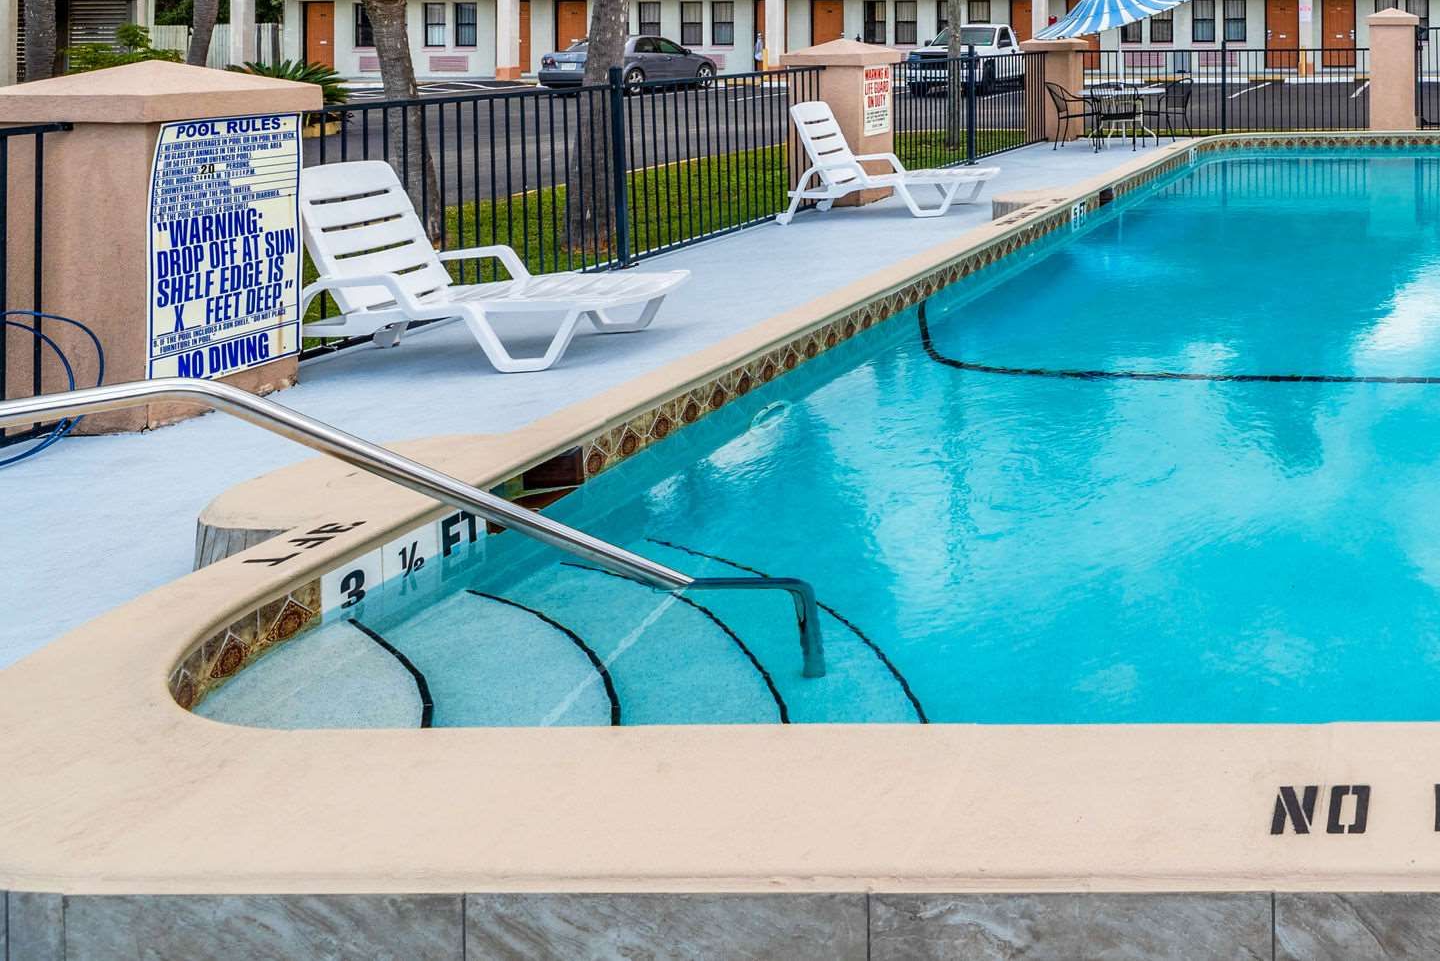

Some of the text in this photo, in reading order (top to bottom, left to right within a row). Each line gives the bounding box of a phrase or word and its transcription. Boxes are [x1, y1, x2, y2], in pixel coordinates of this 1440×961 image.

[865, 82, 873, 95] LIFE
[874, 94, 886, 108] DUTY
[176, 122, 220, 139] POOL
[227, 118, 280, 134] RULES
[201, 164, 215, 174] 20
[157, 228, 294, 279] DROP OFF AT SUN
[157, 256, 284, 308] SHELF EDGE IS
[206, 292, 242, 324] FEET
[166, 335, 176, 344] THE
[178, 331, 190, 341] POOL
[193, 325, 216, 337] INCLUDES
[223, 321, 233, 329] SUN
[160, 339, 189, 354] FURNITURE
[178, 333, 270, 378] NO DIVING
[340, 569, 366, 609] 3
[442, 510, 477, 558] FT
[1270, 785, 1371, 835] NO
